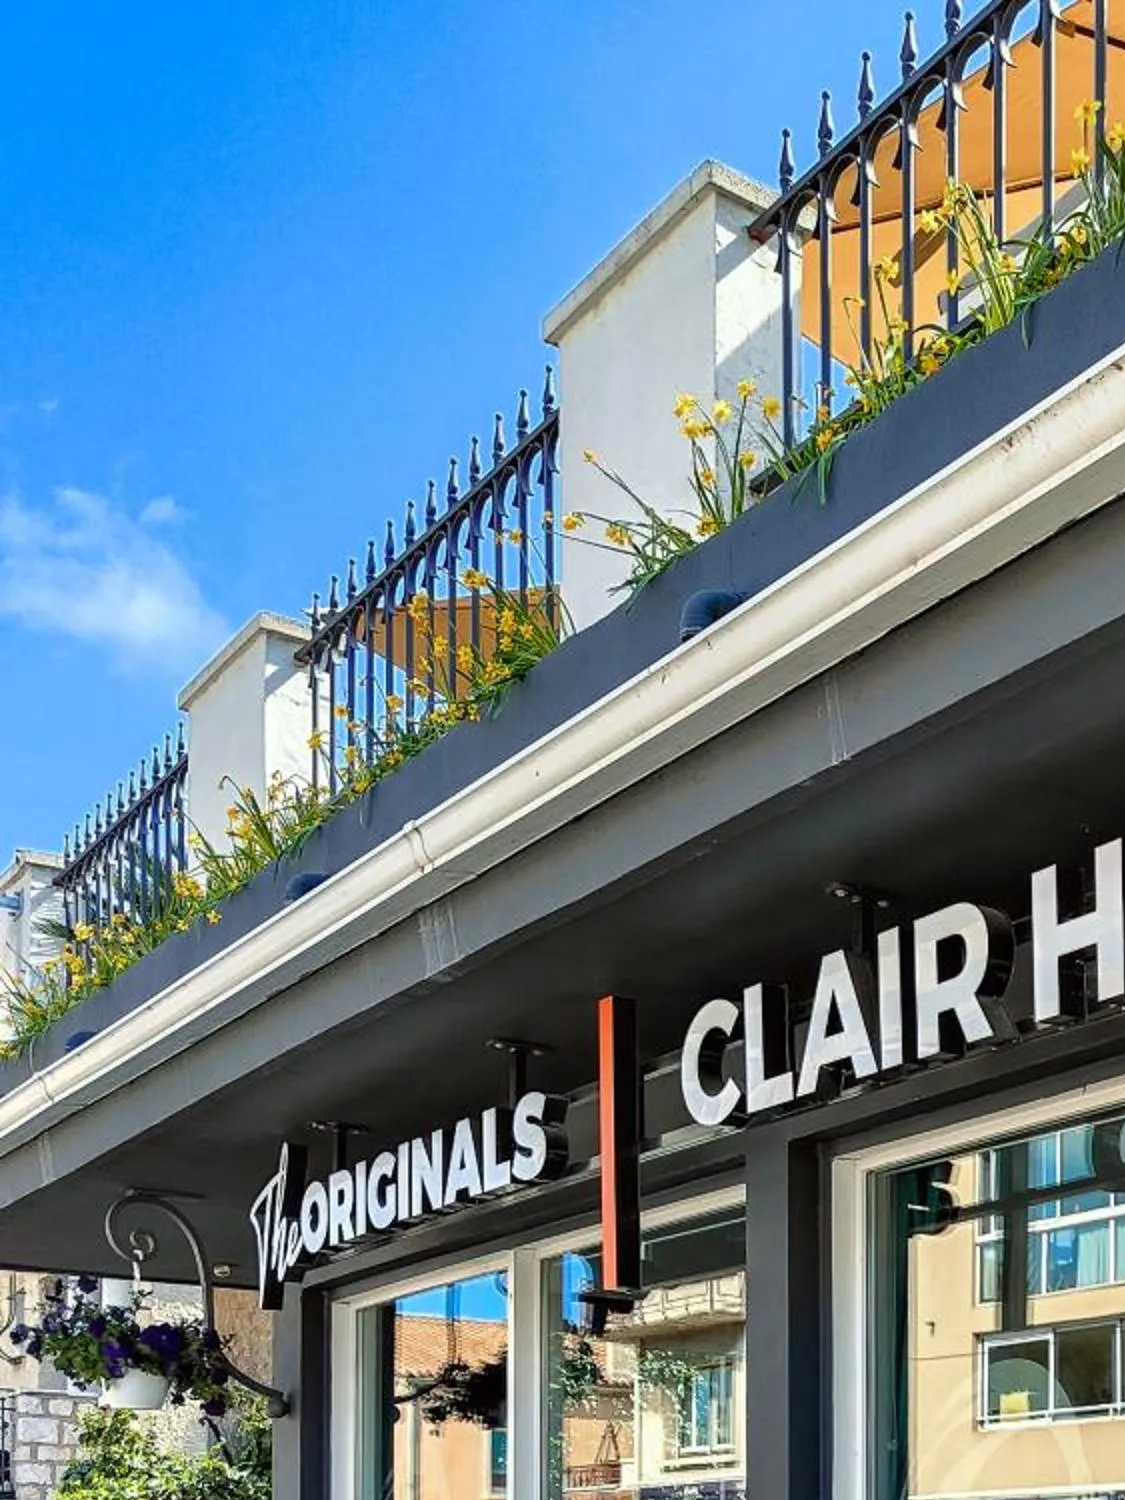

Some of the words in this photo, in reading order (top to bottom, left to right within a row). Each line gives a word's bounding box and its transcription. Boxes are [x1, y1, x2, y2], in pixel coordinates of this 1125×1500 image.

[679, 900, 994, 1128] CLAIR
[249, 1141, 304, 1310] The
[300, 1091, 549, 1256] ORIGINALS
